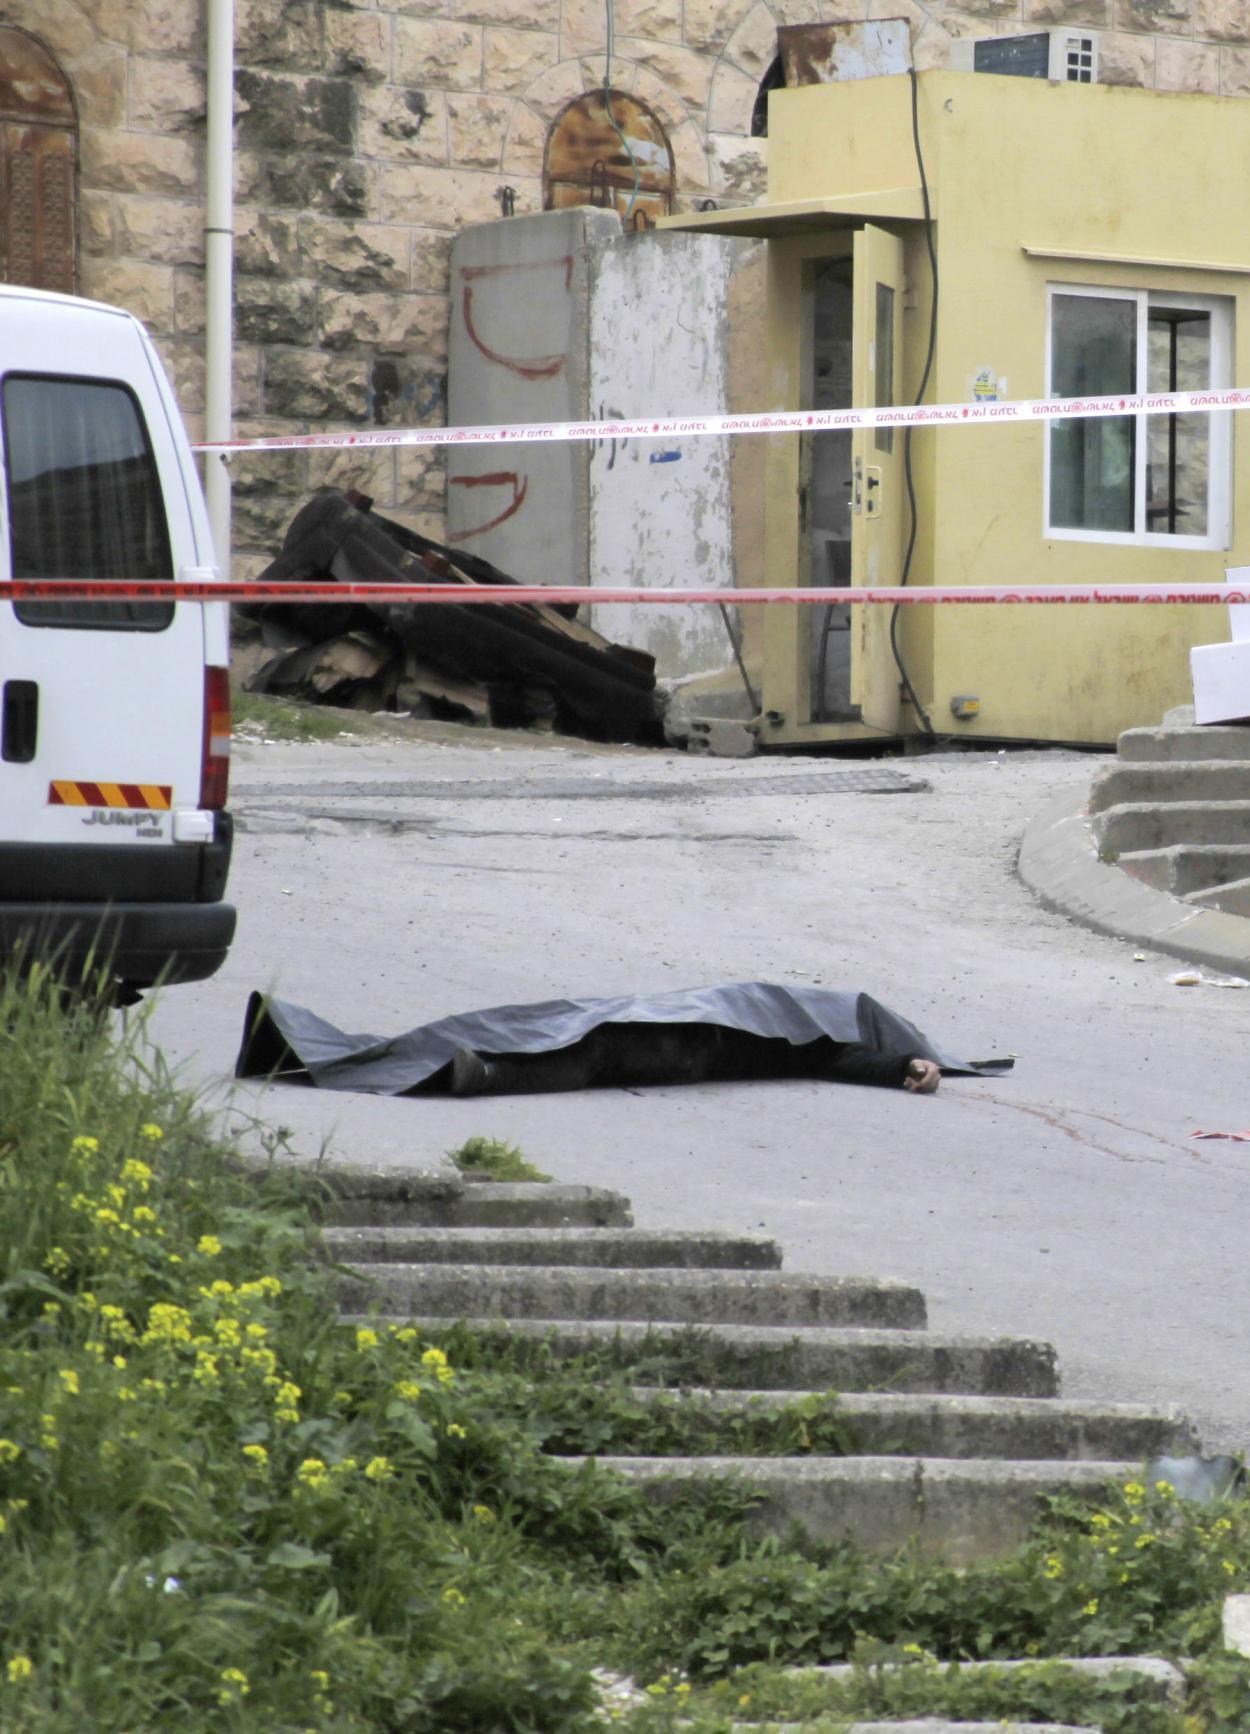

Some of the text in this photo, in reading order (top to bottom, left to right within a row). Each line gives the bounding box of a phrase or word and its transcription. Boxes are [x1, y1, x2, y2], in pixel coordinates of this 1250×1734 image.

[1129, 399, 1143, 410] אין
[1147, 398, 1176, 408] מעבר
[971, 407, 986, 418] אין
[990, 406, 1018, 416] מעבר
[816, 414, 830, 425] אין
[834, 414, 863, 424] מעבר
[662, 422, 677, 432] אין
[680, 422, 707, 432] מעבר
[81, 809, 163, 827] JUMPY
